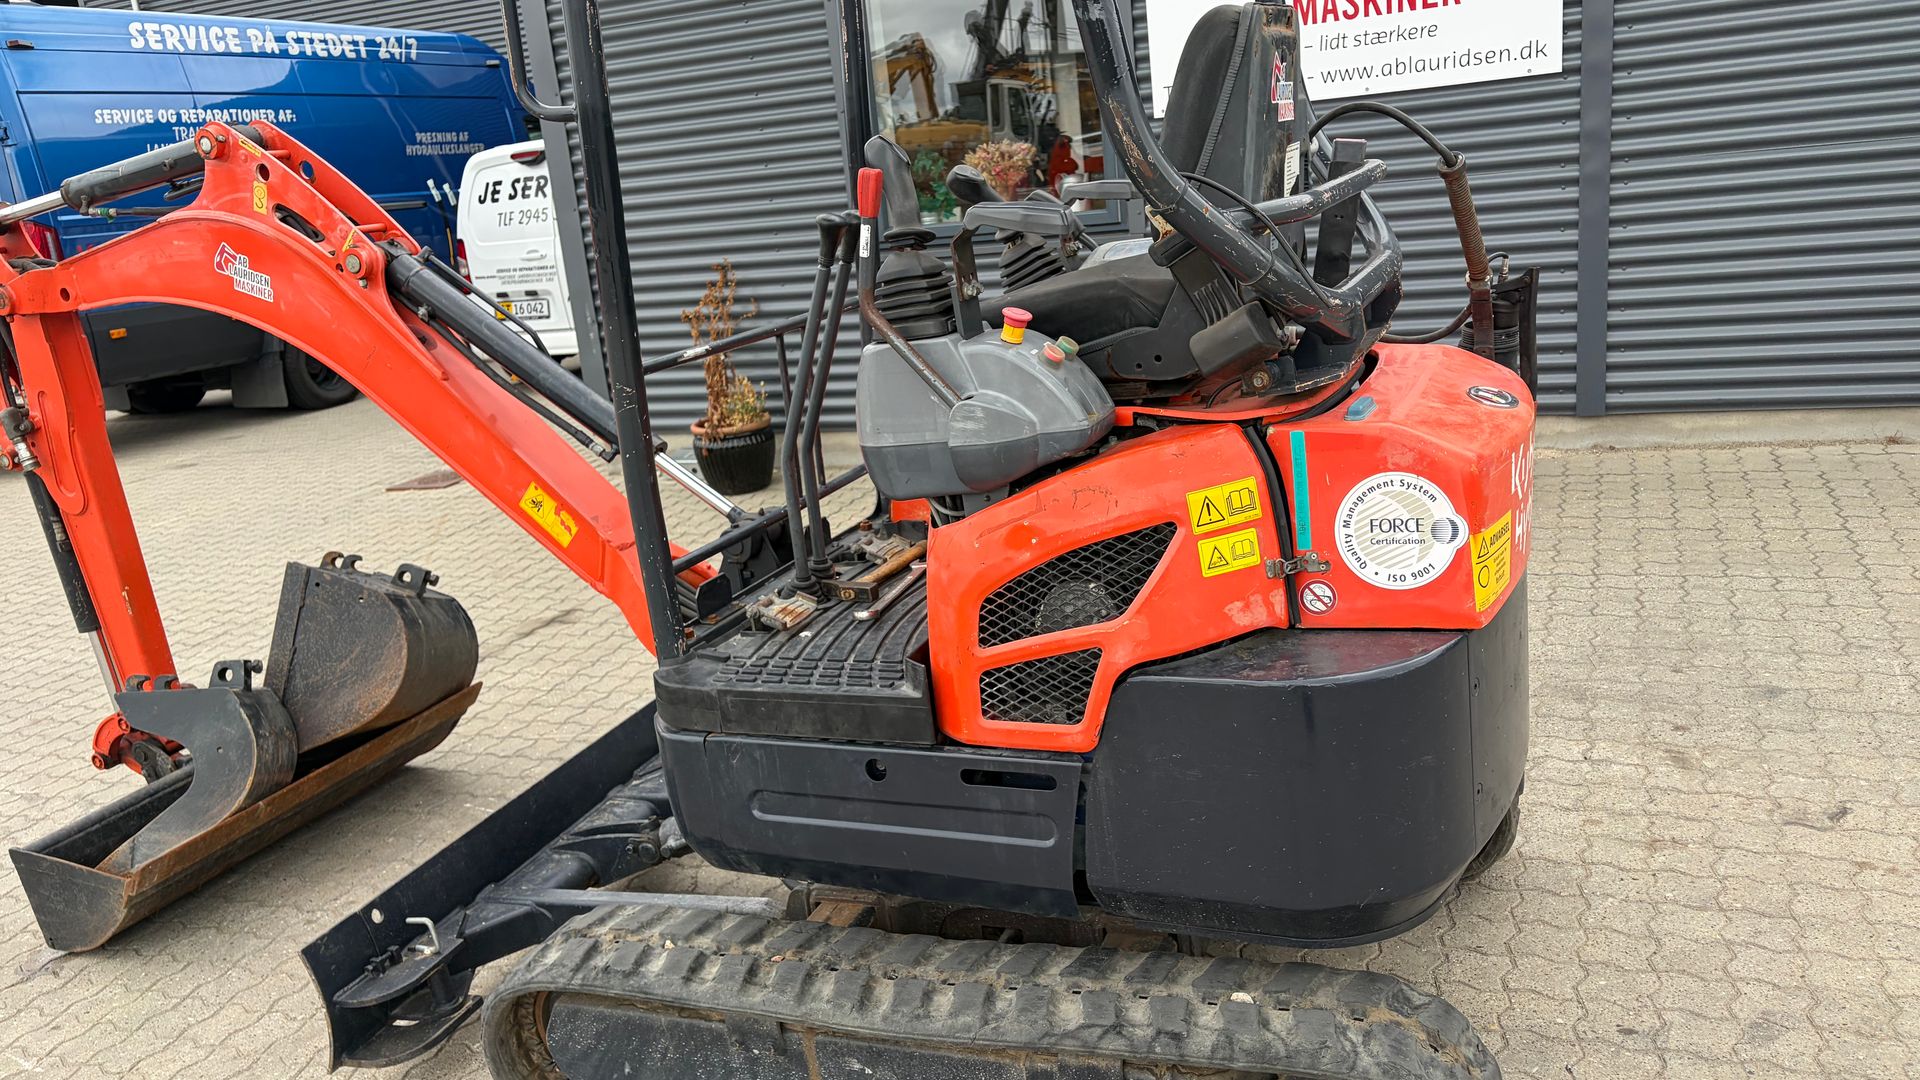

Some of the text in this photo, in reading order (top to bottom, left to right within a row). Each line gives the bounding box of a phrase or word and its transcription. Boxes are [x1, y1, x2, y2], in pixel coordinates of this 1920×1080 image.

[1293, 0, 1461, 25] MASK
[128, 22, 242, 53] SERVICE
[246, 25, 280, 55] PÅ
[285, 31, 367, 59] STEDET
[1319, 33, 1349, 51] lidt
[1353, 24, 1438, 47] stærkere
[1320, 39, 1548, 84] www.ablauridsen.dk
[94, 108, 297, 124] SERVICE OG REPARATIONER AF:
[172, 126, 202, 142] TRA
[415, 131, 469, 143] PRESNING AF
[405, 143, 485, 156] HYDRAULIKSLANGER
[478, 175, 549, 204] JE SER
[497, 207, 549, 227] TLF 2945
[238, 255, 248, 268] AB
[229, 264, 270, 288] LAURIDSEN
[235, 278, 273, 300] MASKINER
[514, 303, 525, 315] 16
[526, 302, 544, 314] 042
[1342, 479, 1437, 570] Quality Management System
[1370, 517, 1425, 533] FORCE
[1370, 537, 1426, 546] Certification
[1387, 562, 1436, 583] ISO 9001
